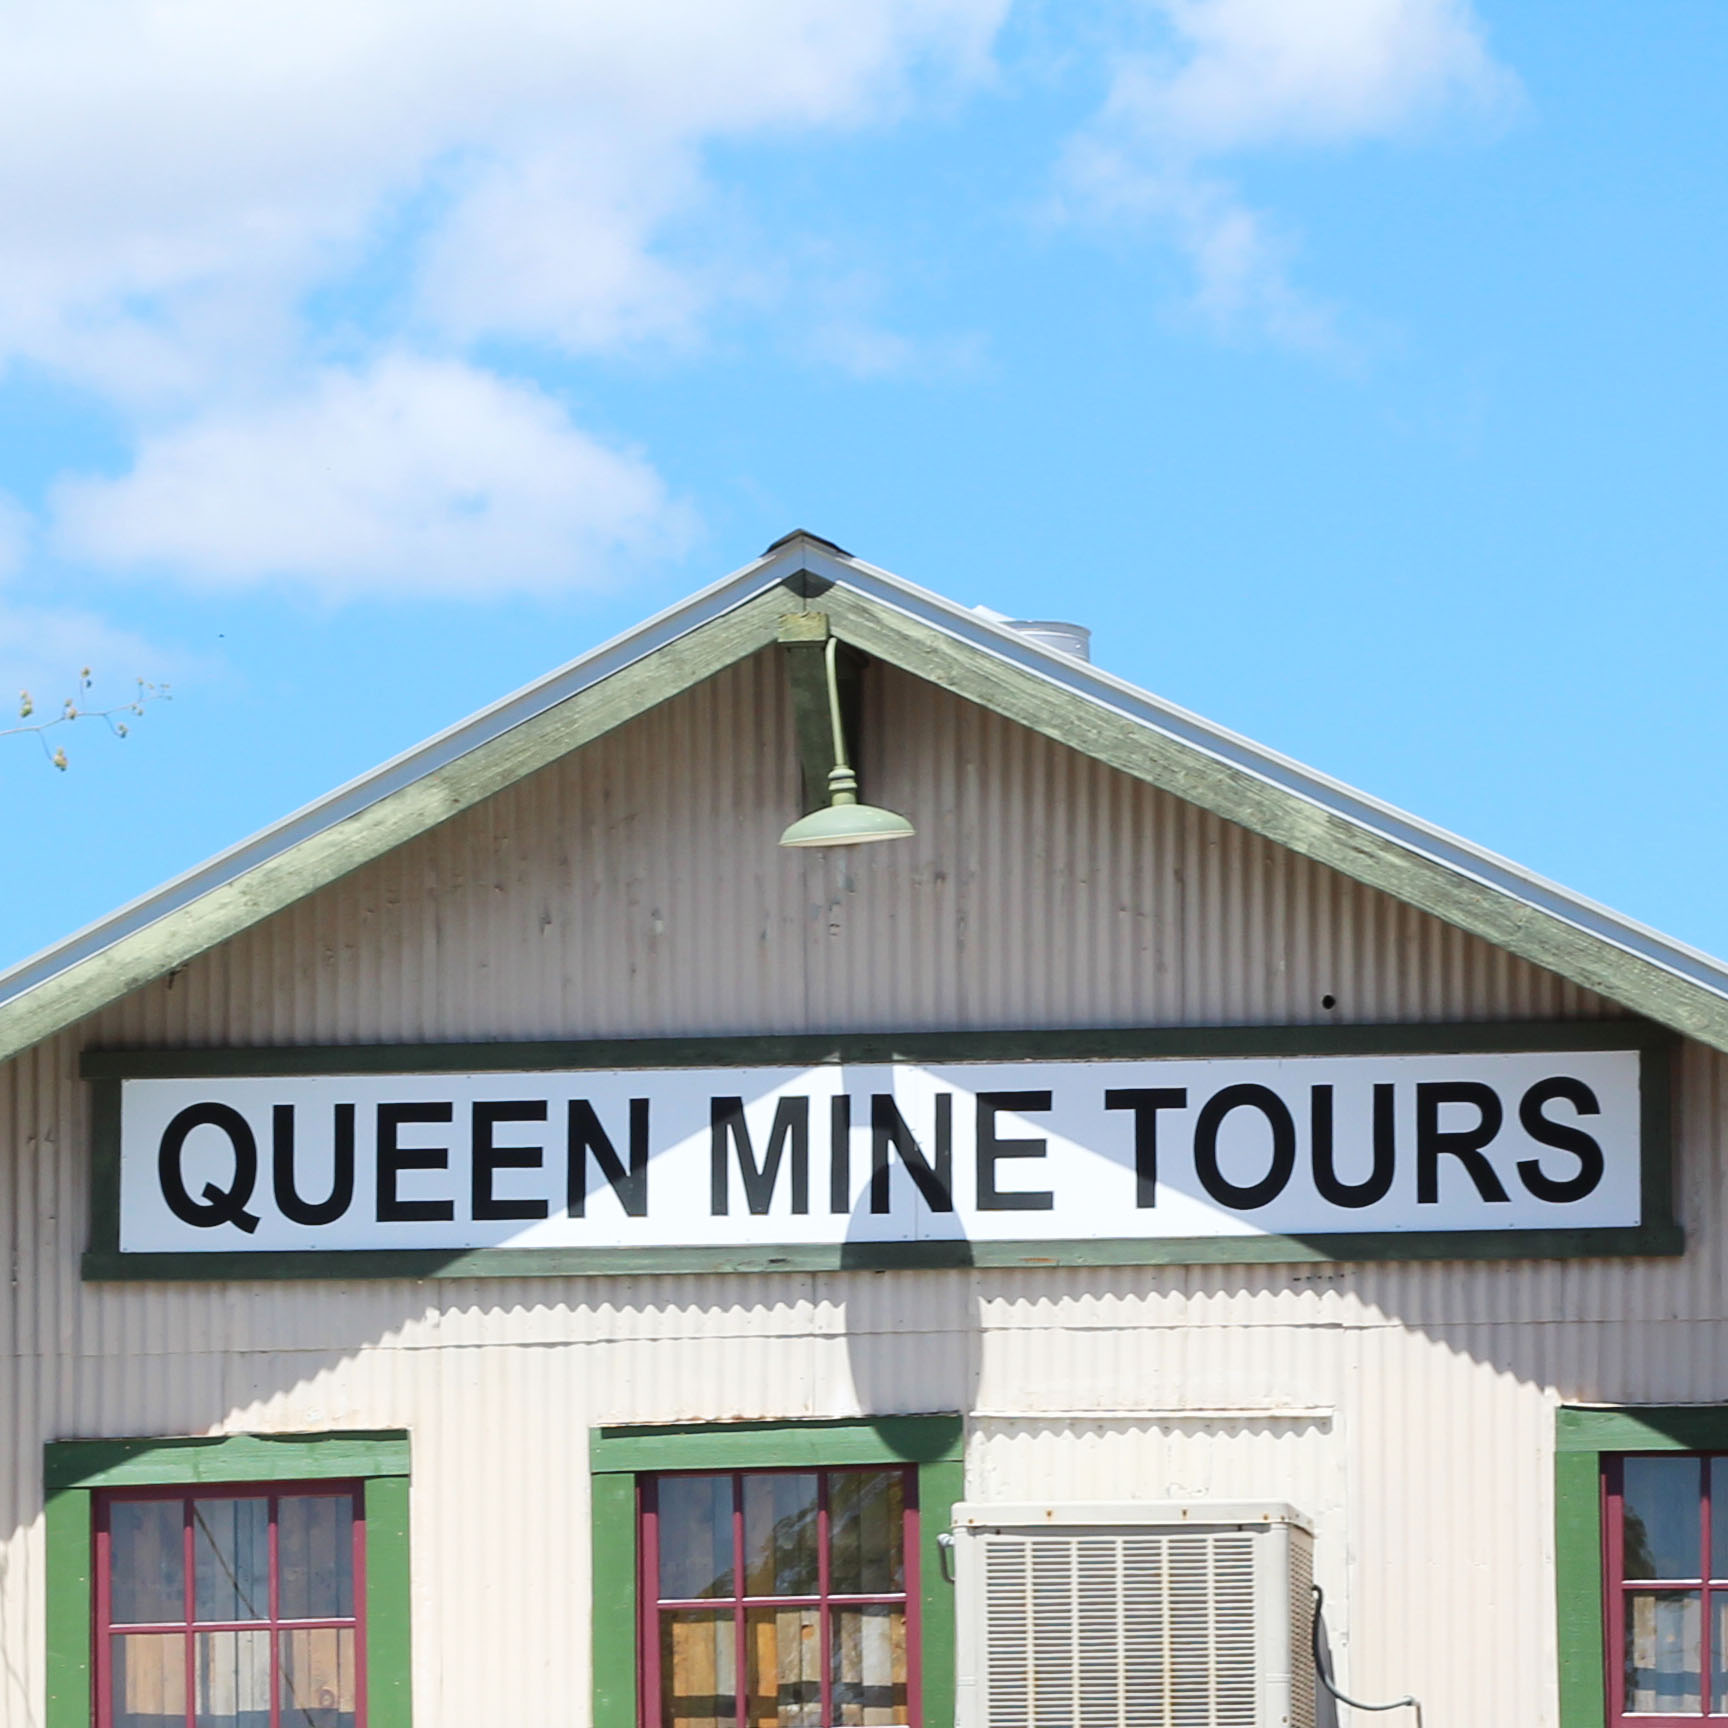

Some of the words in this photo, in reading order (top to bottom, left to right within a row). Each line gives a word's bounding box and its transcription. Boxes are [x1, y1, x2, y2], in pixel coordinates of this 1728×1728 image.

[158, 1098, 651, 1235] QUEEN
[710, 1090, 1054, 1216] MINE
[1104, 1076, 1605, 1210] TOURS
